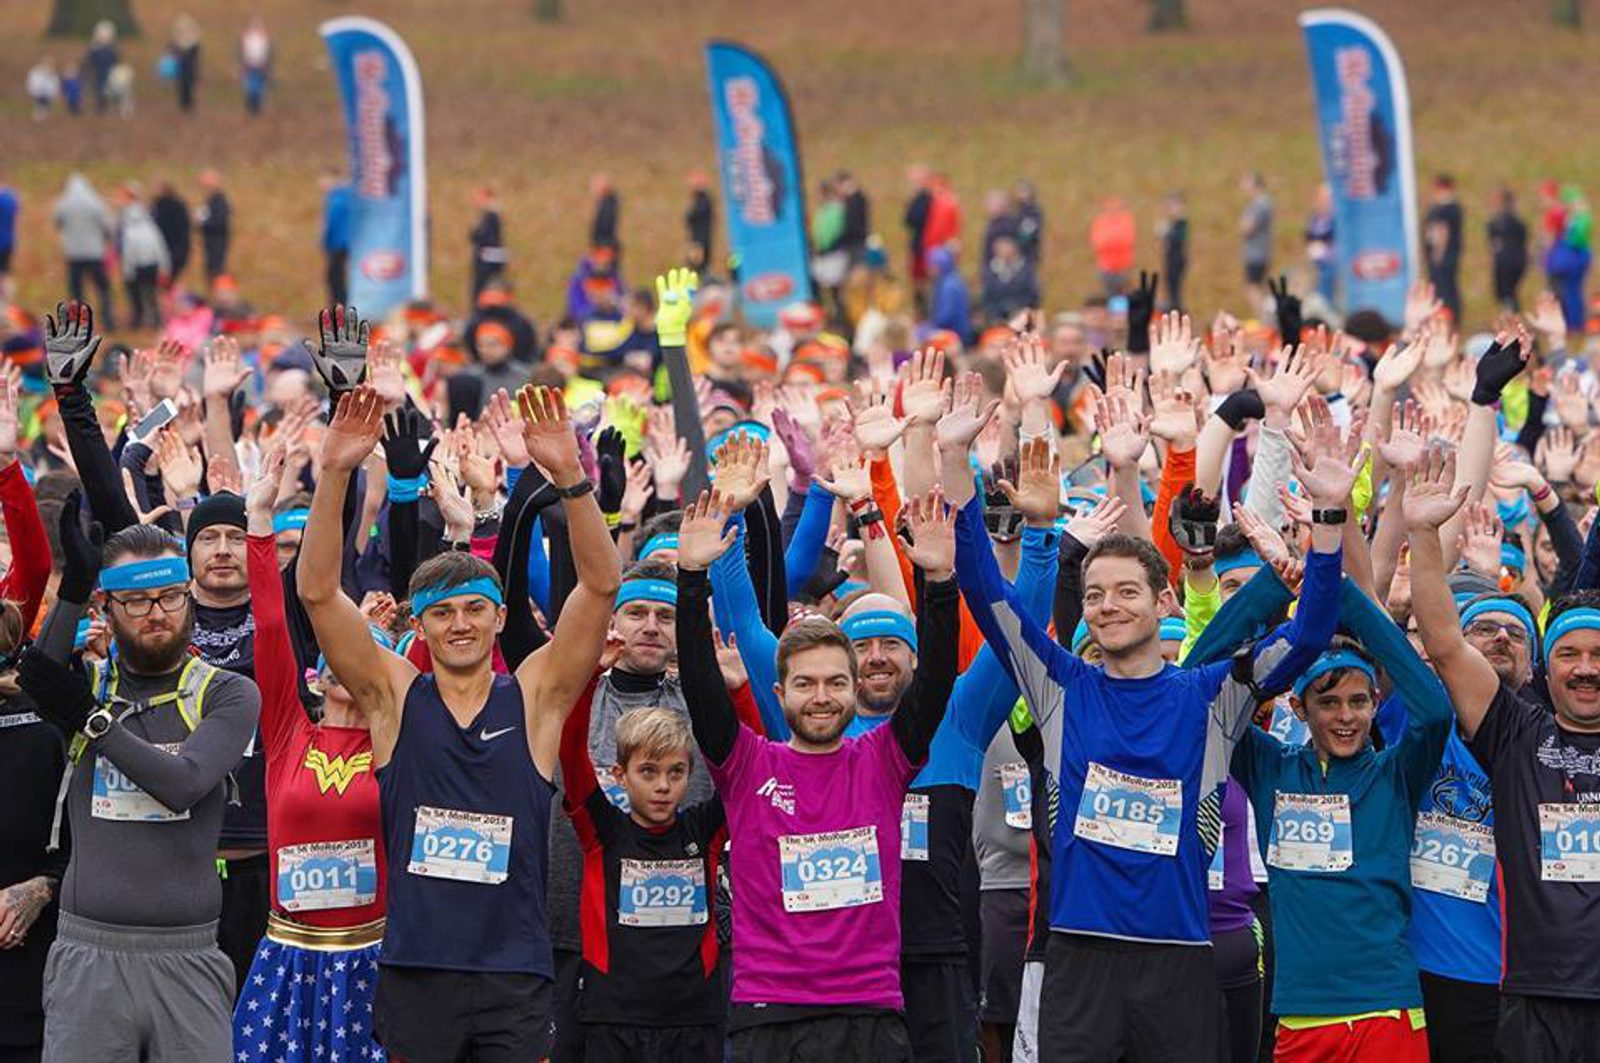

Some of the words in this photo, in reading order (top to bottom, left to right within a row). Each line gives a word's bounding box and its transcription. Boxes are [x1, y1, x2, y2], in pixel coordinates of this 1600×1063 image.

[1093, 764, 1107, 776] The
[1120, 774, 1155, 789] MoRun
[1156, 779, 1178, 789] 2018
[1094, 792, 1165, 826] 0185
[1288, 794, 1319, 803] MoRun
[1321, 795, 1345, 805] 2018
[449, 811, 481, 822] MoRun
[483, 815, 507, 825] 2018
[310, 843, 343, 852] MoRun
[345, 840, 369, 850] 2018
[785, 836, 801, 844] The
[818, 832, 850, 841] MoRun
[424, 835, 493, 863] 0276
[626, 860, 638, 868] The
[798, 854, 868, 882] 0324
[291, 865, 357, 891] 0011
[632, 885, 695, 906] 0292
